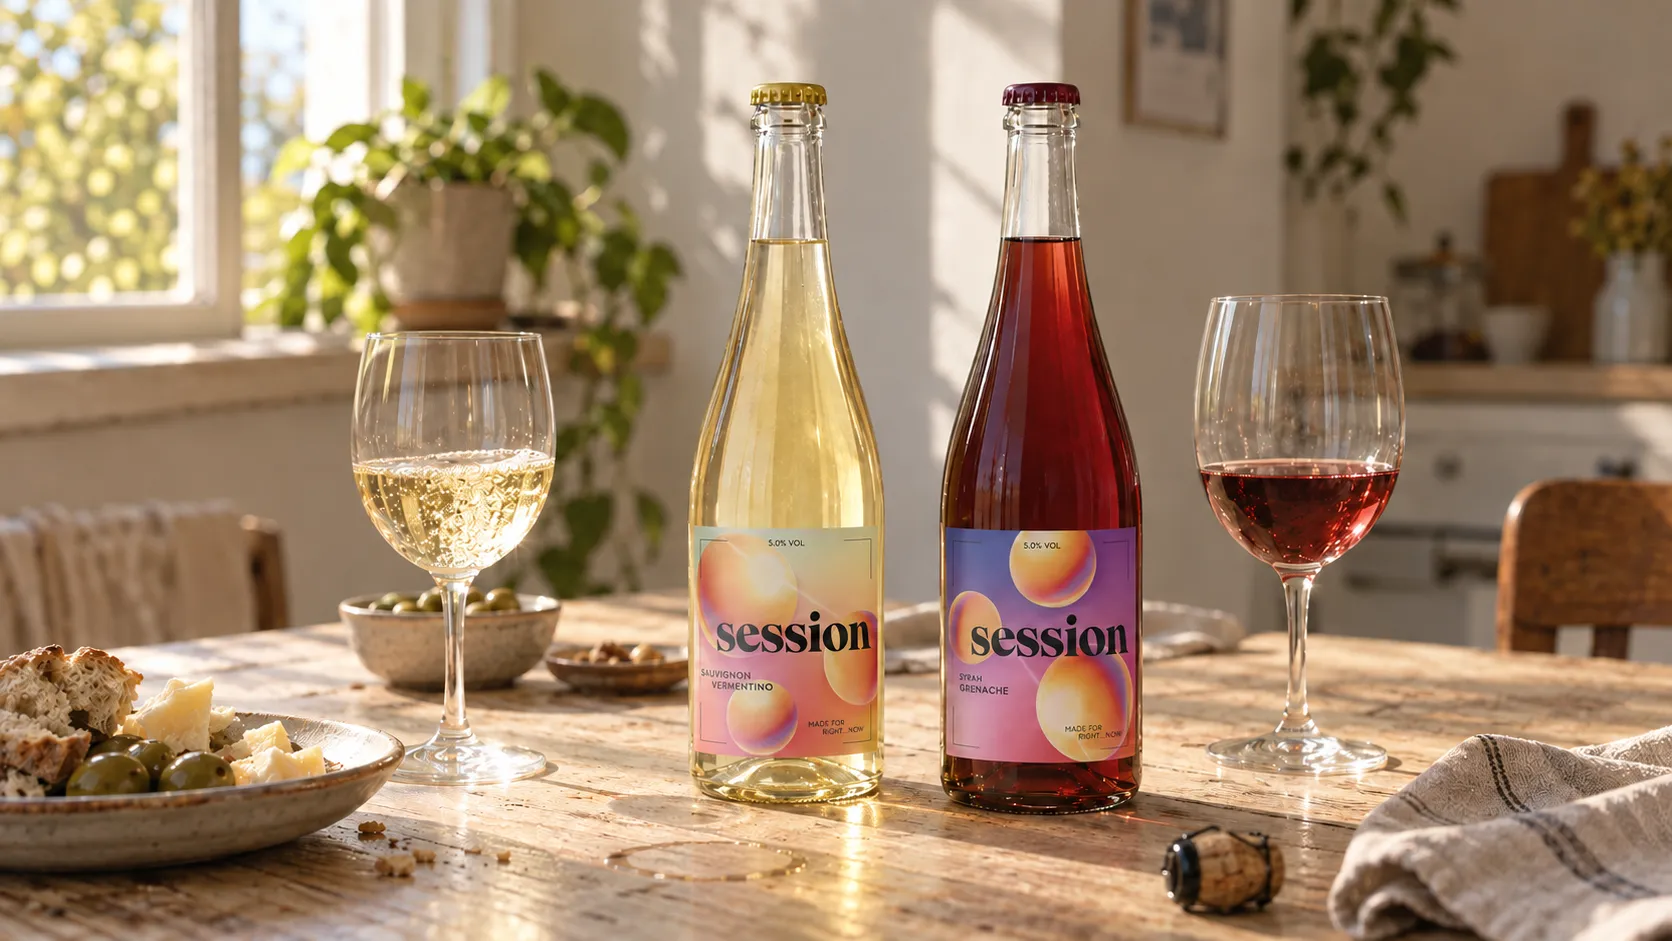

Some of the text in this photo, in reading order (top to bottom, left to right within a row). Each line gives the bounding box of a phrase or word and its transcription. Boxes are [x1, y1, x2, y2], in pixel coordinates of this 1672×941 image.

[768, 538, 805, 547] 5.0% VOL
[1023, 541, 1061, 550] 5.0% VOL
[716, 610, 872, 653] session
[970, 614, 1128, 658] session
[700, 668, 751, 680] SAUVIGNON
[959, 672, 983, 682] SYRAH
[711, 681, 774, 691] VERMENTINO
[959, 683, 1009, 696] GRENACHE
[808, 719, 845, 728] MADE FOR
[1064, 724, 1103, 733] MADE FOR
